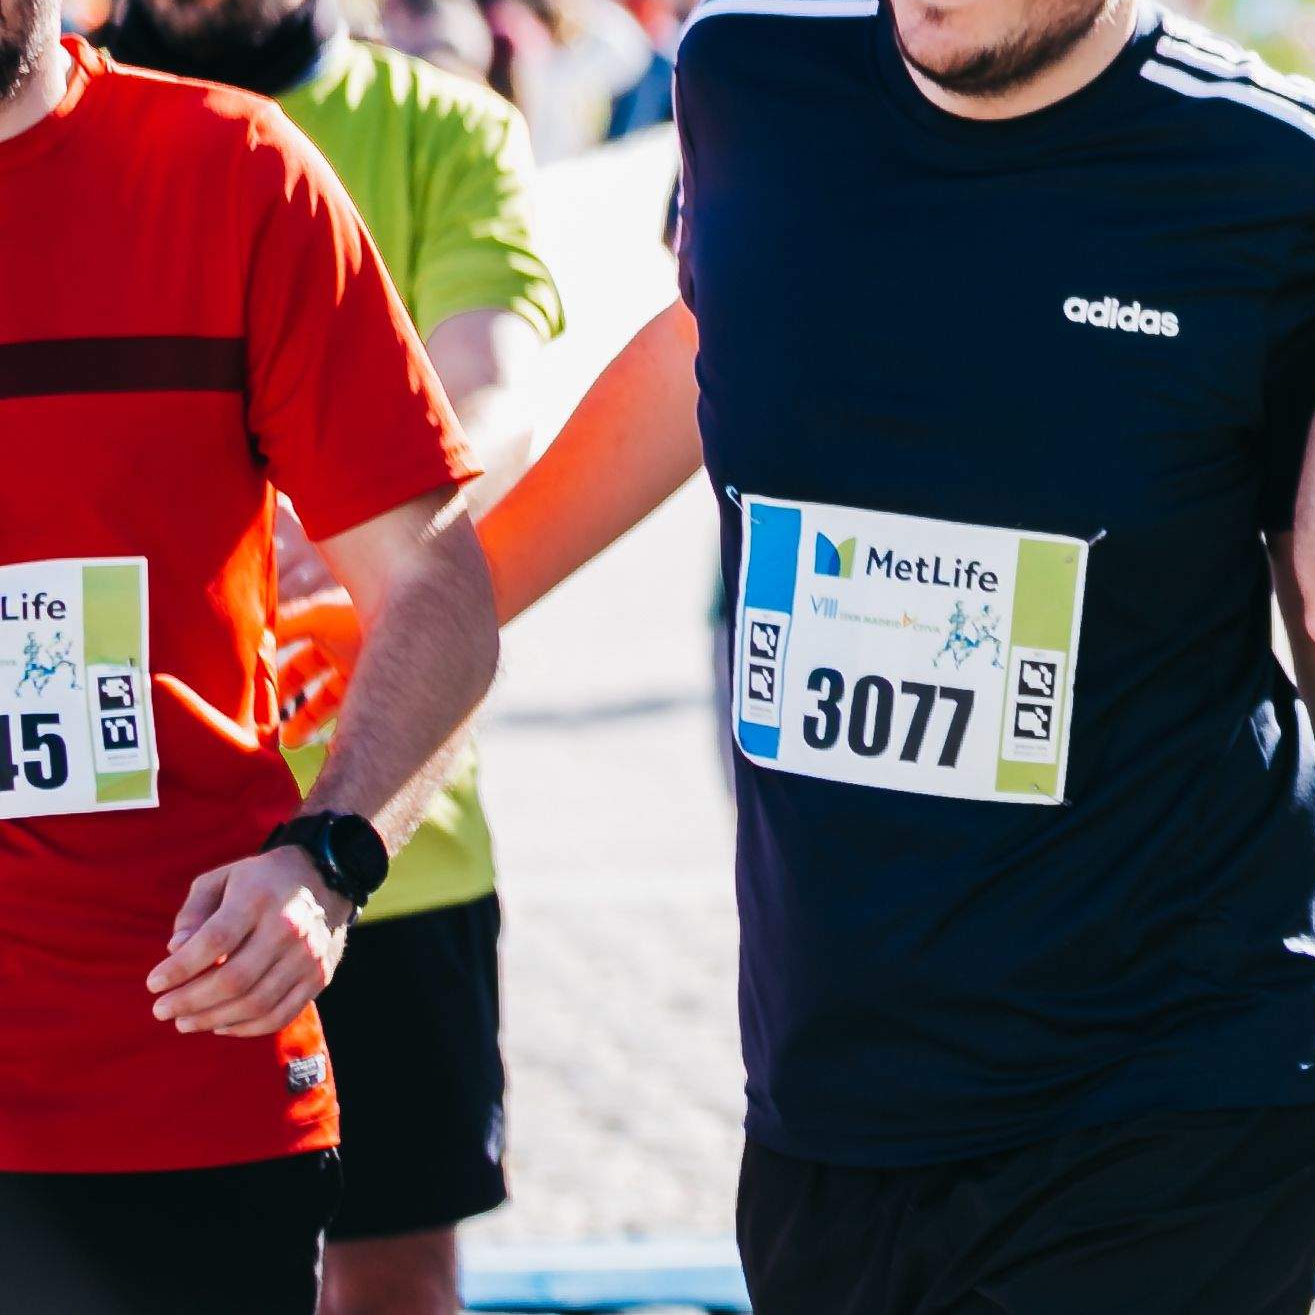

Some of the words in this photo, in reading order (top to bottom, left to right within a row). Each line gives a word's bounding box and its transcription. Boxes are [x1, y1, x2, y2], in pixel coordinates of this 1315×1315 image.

[1063, 296, 1180, 337] adidas
[865, 546, 999, 593] MetLife
[1, 592, 67, 621] Life
[802, 666, 975, 769] 3077
